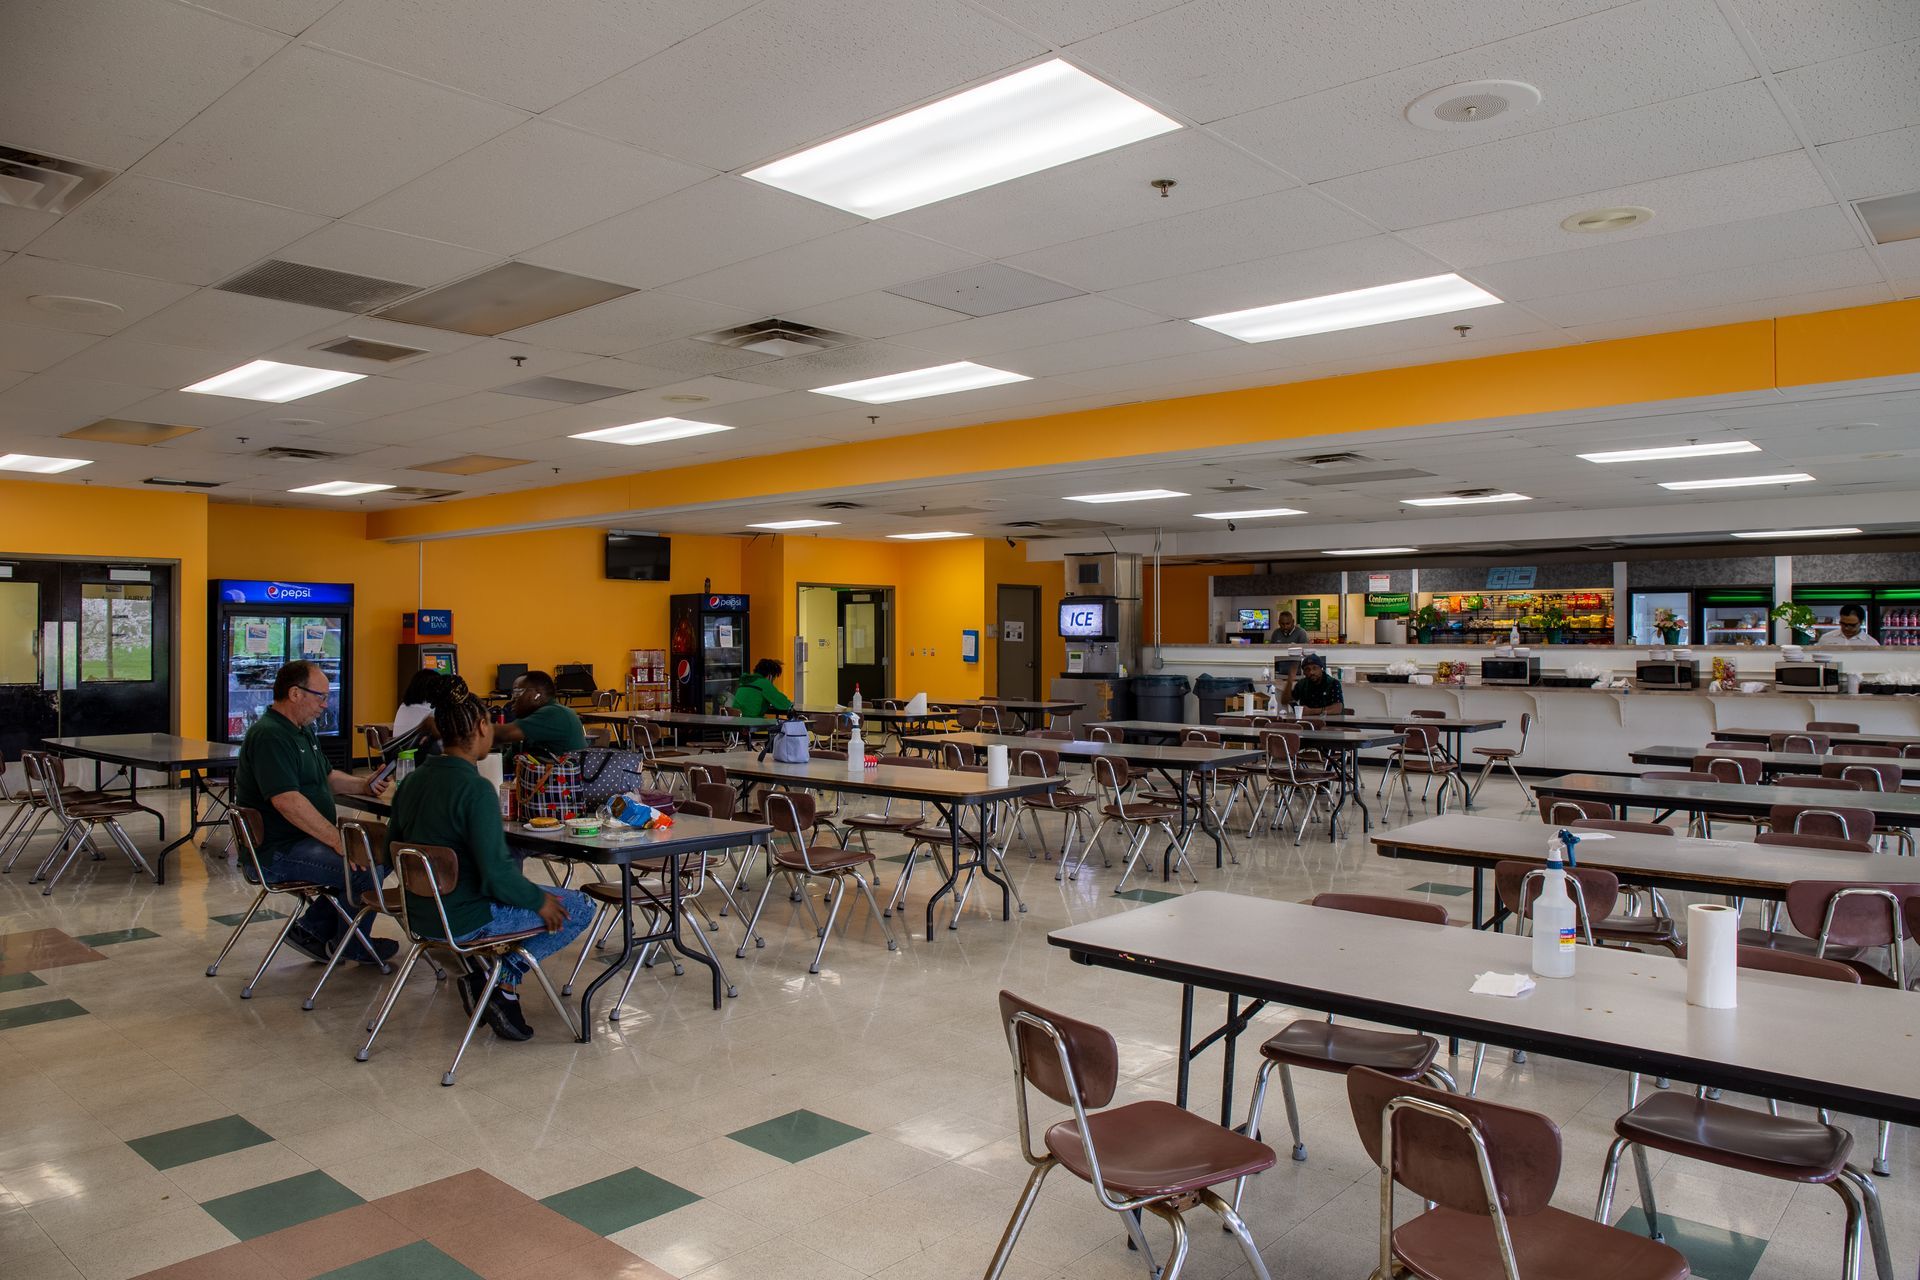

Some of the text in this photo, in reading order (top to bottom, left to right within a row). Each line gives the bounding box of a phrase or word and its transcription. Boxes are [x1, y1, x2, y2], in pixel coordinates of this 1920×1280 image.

[281, 588, 312, 599] pepsi
[720, 599, 741, 607] pepsi
[1070, 612, 1094, 626] ICE
